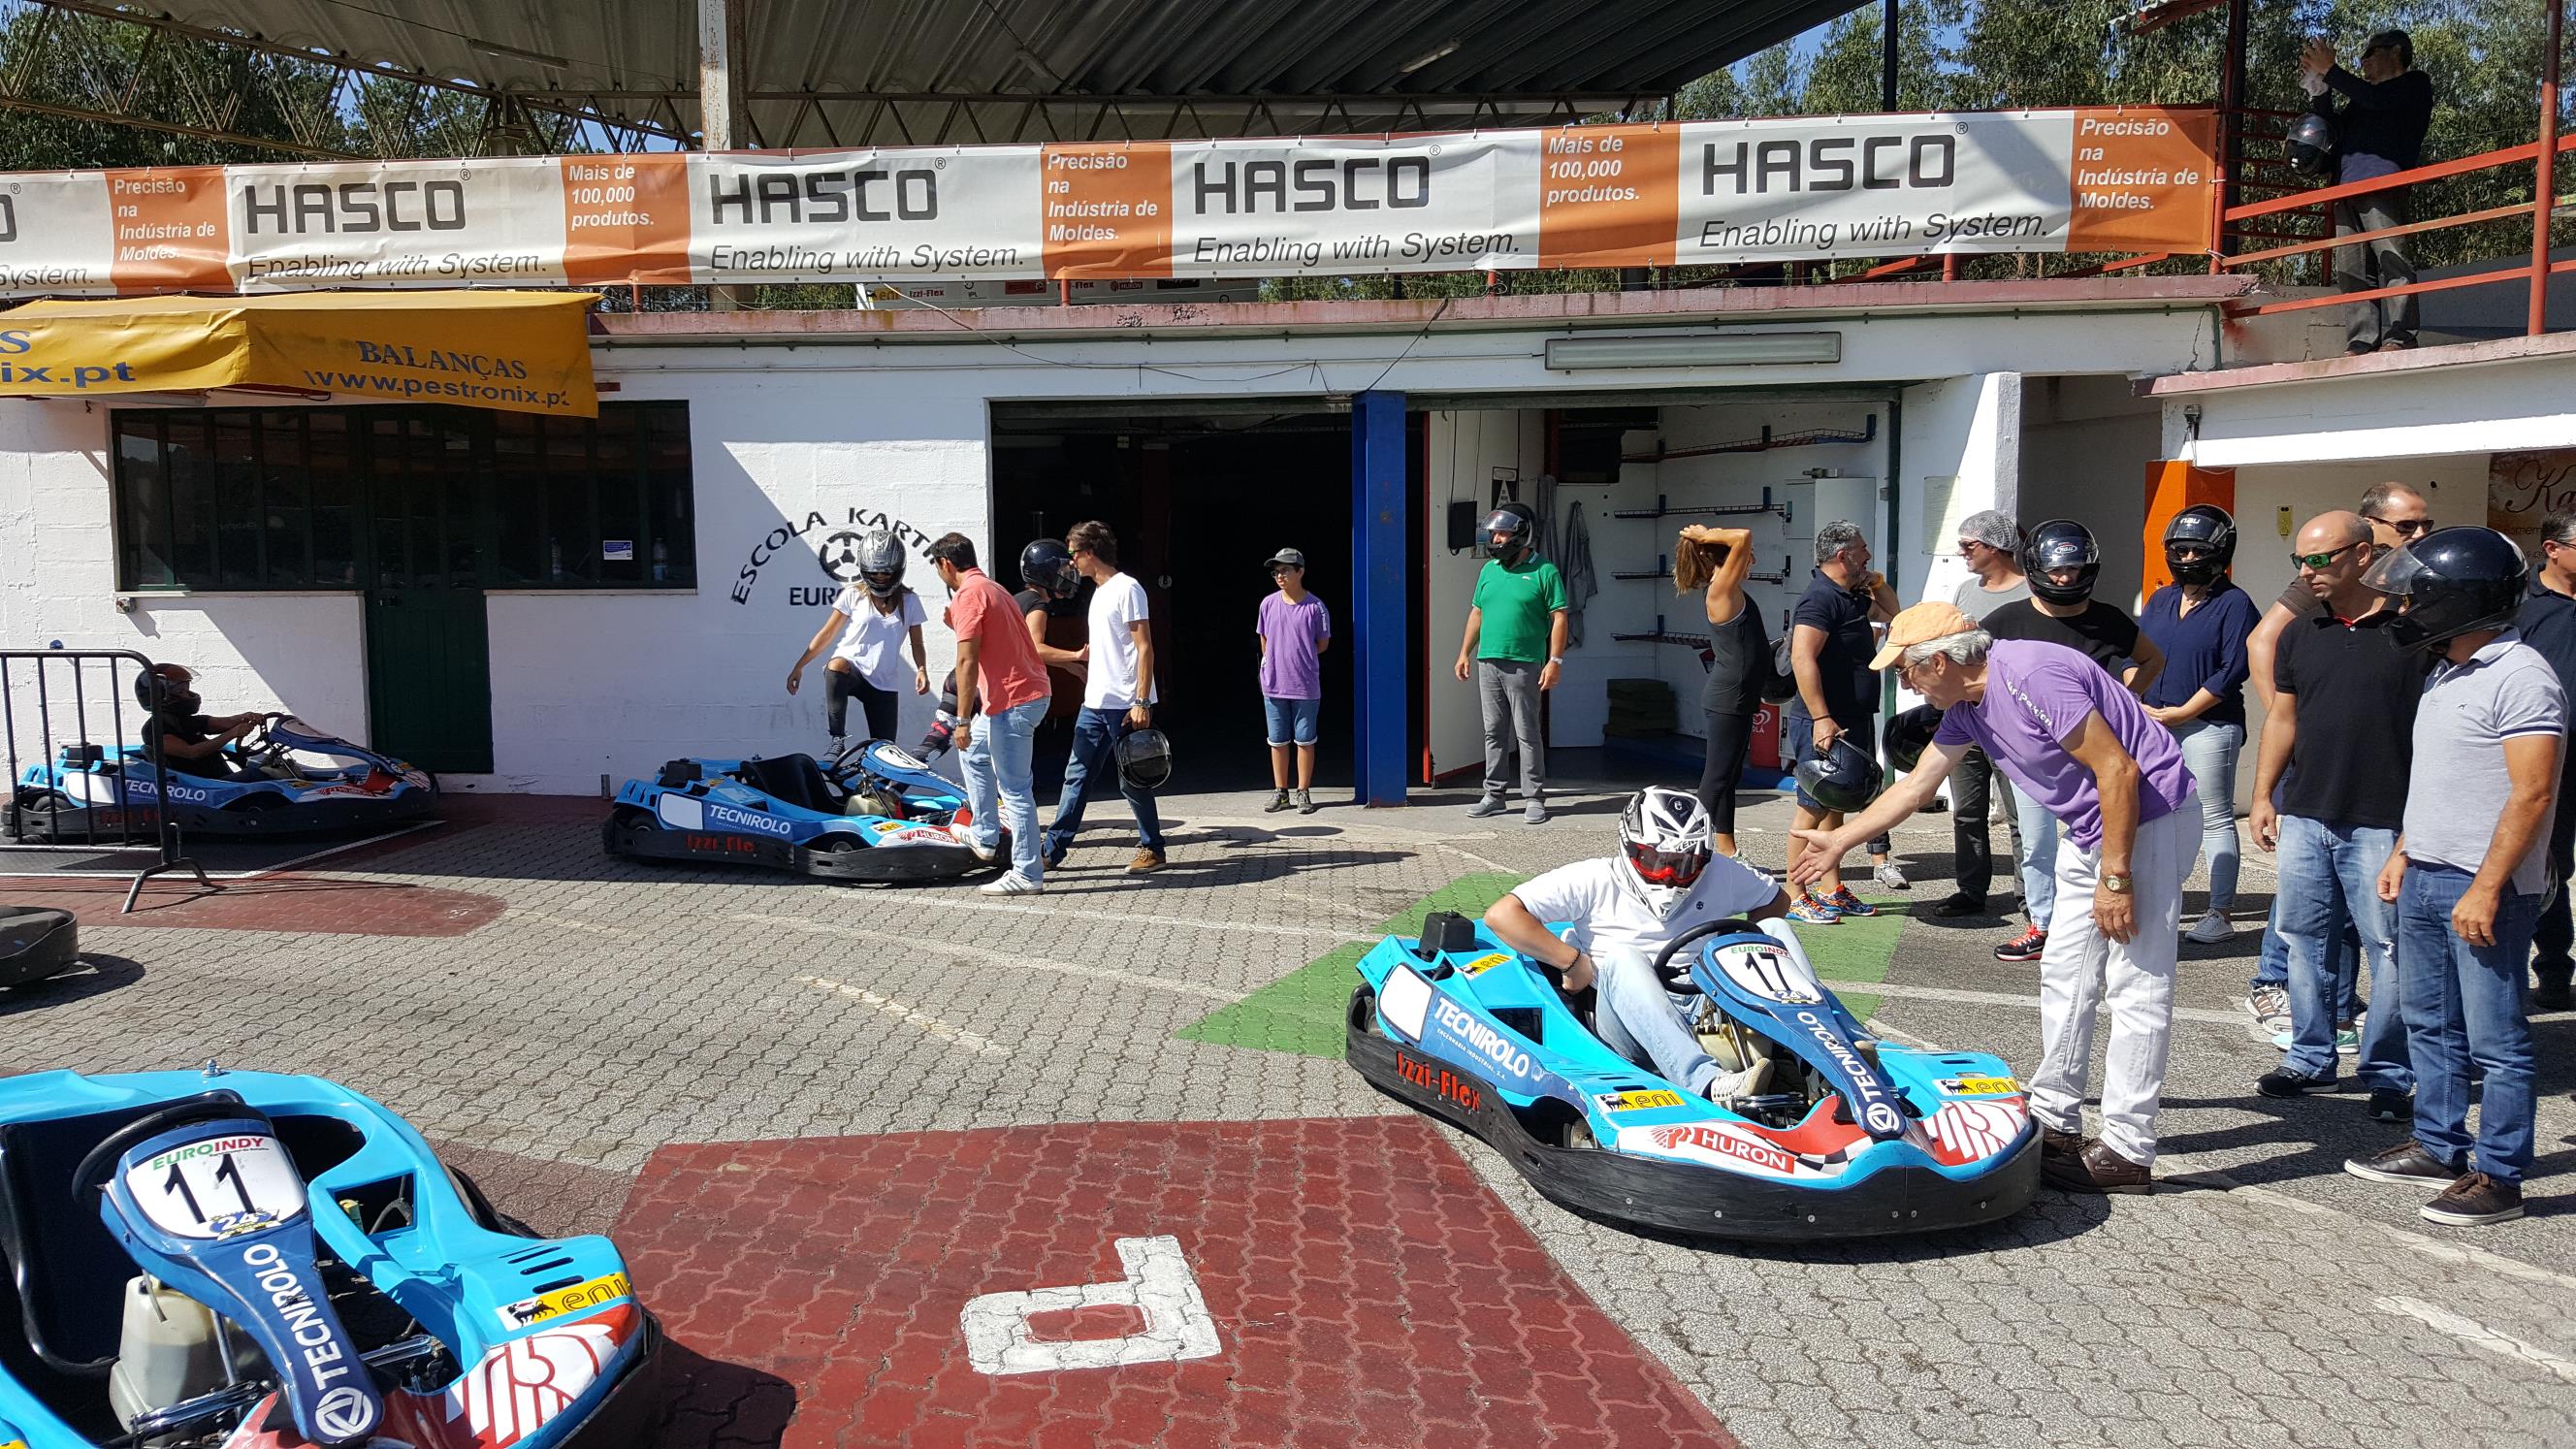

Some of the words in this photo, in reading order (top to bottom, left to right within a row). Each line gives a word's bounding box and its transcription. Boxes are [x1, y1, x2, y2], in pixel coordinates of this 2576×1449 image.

[2080, 118, 2170, 137] Precisão
[1548, 136, 1595, 154] Mais
[1599, 135, 1623, 153] de
[2078, 145, 2104, 161] na
[1047, 152, 1128, 170] Precisão
[1548, 159, 1622, 180] 100,000
[1702, 134, 1955, 195] HASCO
[568, 164, 609, 181] Mais
[614, 163, 635, 179] de
[2077, 168, 2168, 186] Indústria
[2174, 167, 2199, 185] de
[114, 178, 186, 195] Precisão
[1047, 178, 1070, 194] na
[1194, 155, 1431, 215] HASCO
[1546, 184, 1640, 207] produtos.
[571, 186, 635, 206] 100,000
[709, 169, 938, 225] HASCO
[2078, 192, 2155, 209] Moldes.
[117, 204, 138, 217] na
[244, 180, 466, 234] HASCO
[1047, 200, 1131, 218] Indústria
[1135, 200, 1158, 216] de
[119, 223, 192, 240] Indústria
[196, 221, 216, 237] de
[571, 210, 655, 231] produtos.
[1699, 218, 1838, 250] Enabling
[1850, 214, 1912, 242] with
[1922, 212, 2047, 244] System.
[1048, 224, 1120, 242] Moldes.
[119, 244, 180, 262] Moldes.
[711, 244, 834, 274] Enabling
[844, 244, 900, 269] with
[909, 243, 1025, 273] System.
[1194, 236, 1320, 267] Enabling
[1333, 234, 1391, 259] with
[1401, 230, 1520, 264] System.
[248, 254, 369, 280] Enabling
[376, 255, 429, 275] with
[436, 252, 547, 279] System.
[356, 340, 528, 380] BALANÇAS
[730, 511, 827, 605] ESCOLA
[125, 779, 206, 801] TECNROLO
[709, 804, 791, 834] TECNIROLO
[920, 830, 956, 844] HURON
[1731, 946, 1789, 957] EUROINDY
[1479, 954, 1511, 971] eni
[1745, 952, 1792, 991] 17
[1434, 997, 1530, 1078] TECNIROLO
[1796, 1012, 1883, 1103] TECNIROLO
[1397, 1050, 1481, 1112] Izzi-Flex
[1976, 1080, 2020, 1094] eni
[1635, 1093, 1681, 1108] eni
[152, 1138, 265, 1171] EUROINDY
[1701, 1130, 1787, 1171] HURON
[163, 1153, 256, 1224] 11
[562, 1278, 628, 1311] eni
[242, 1244, 348, 1391] TECNIROLO
